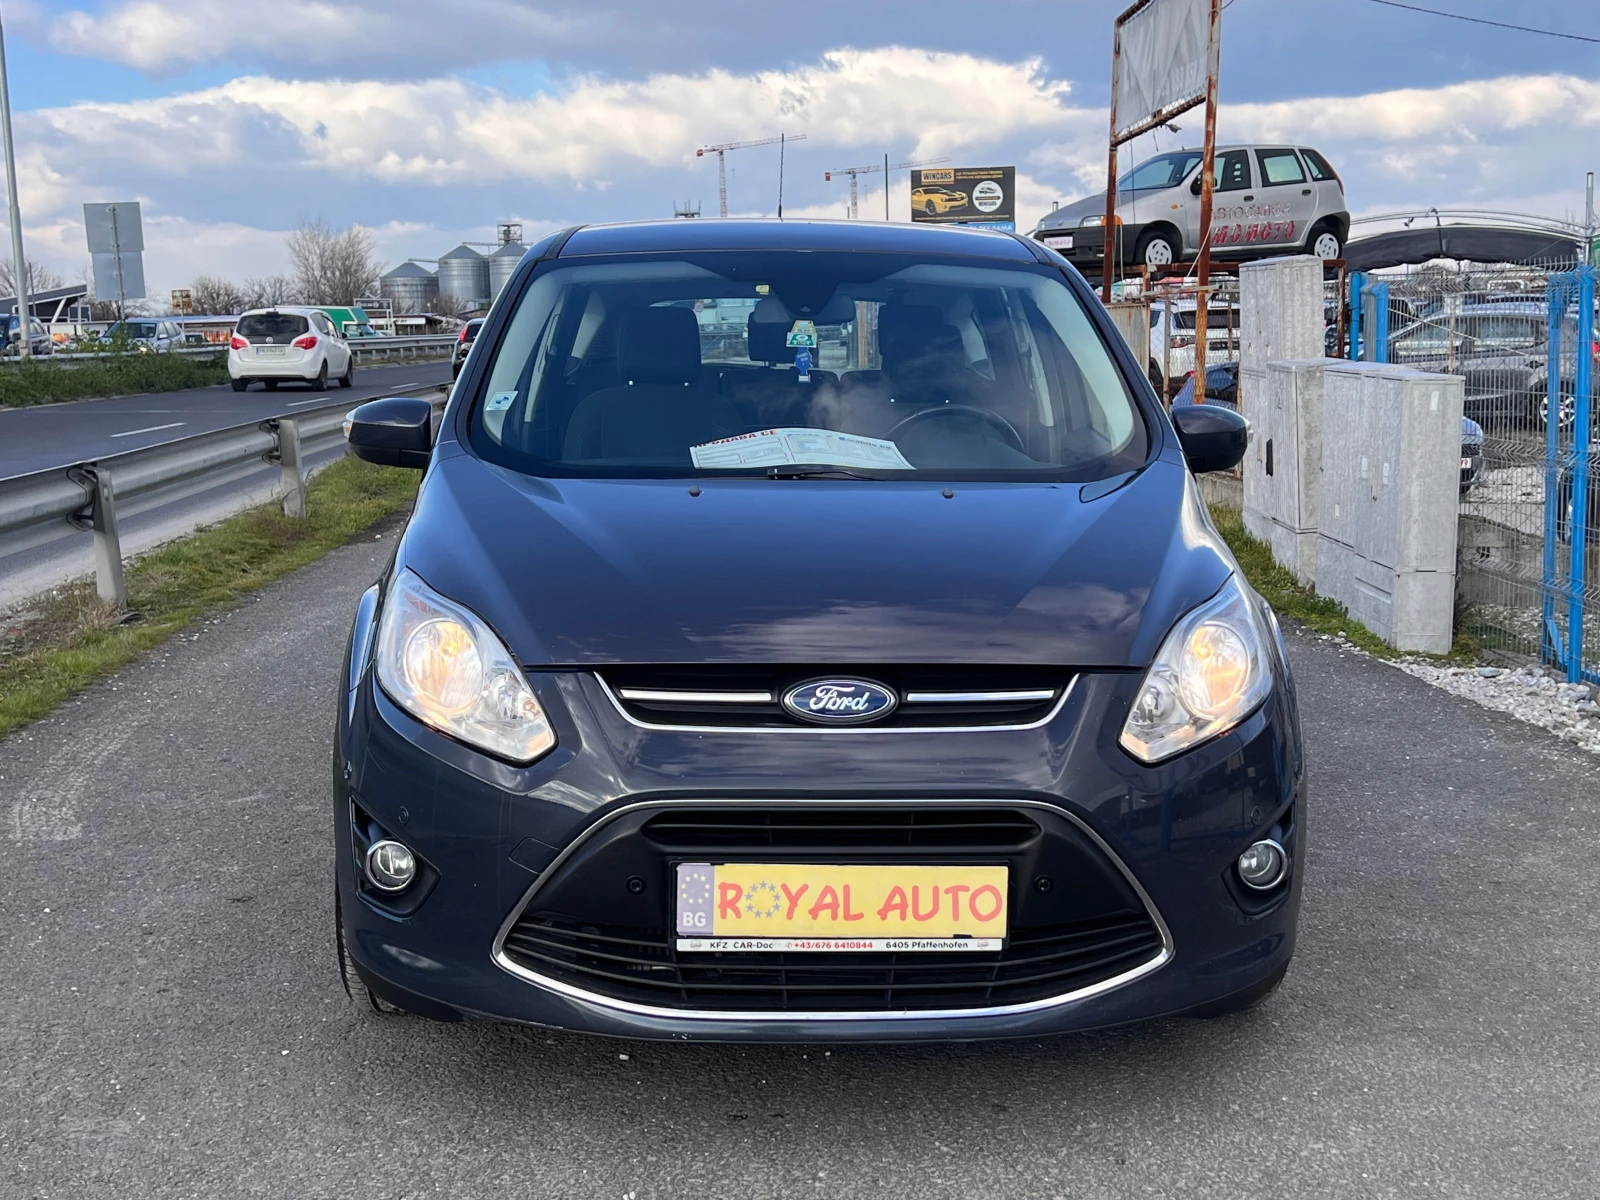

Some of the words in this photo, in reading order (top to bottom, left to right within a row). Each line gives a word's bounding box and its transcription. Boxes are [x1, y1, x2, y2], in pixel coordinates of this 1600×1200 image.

[923, 171, 952, 180] WINCARS
[809, 685, 870, 710] Ford
[876, 884, 1003, 922] AUTO
[682, 911, 707, 927] BG
[709, 941, 728, 949] KFZ
[733, 941, 774, 949] CAR-Doc
[794, 941, 832, 950] +43/676
[834, 941, 873, 949] 6410844
[885, 941, 909, 949] 6405
[911, 941, 969, 949] Pfaffenhofen
